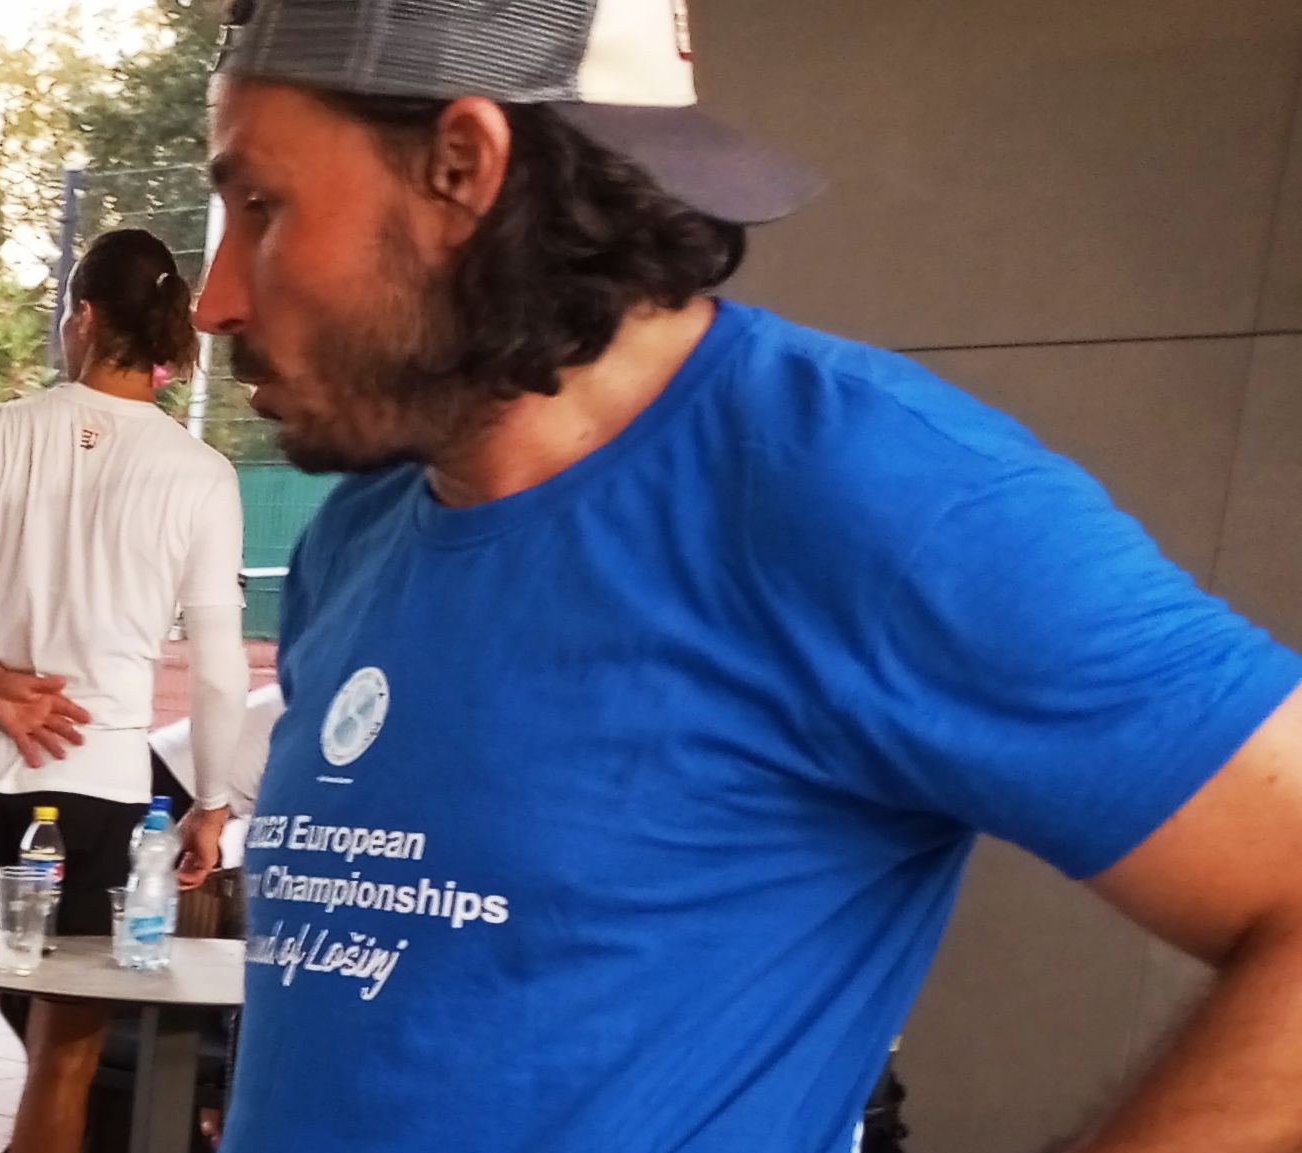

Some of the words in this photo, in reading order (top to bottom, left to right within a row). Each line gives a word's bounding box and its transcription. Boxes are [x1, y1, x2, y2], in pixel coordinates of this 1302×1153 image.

[288, 815, 426, 862] European
[262, 865, 510, 929] Championships
[304, 929, 410, 1001] Lošinj
